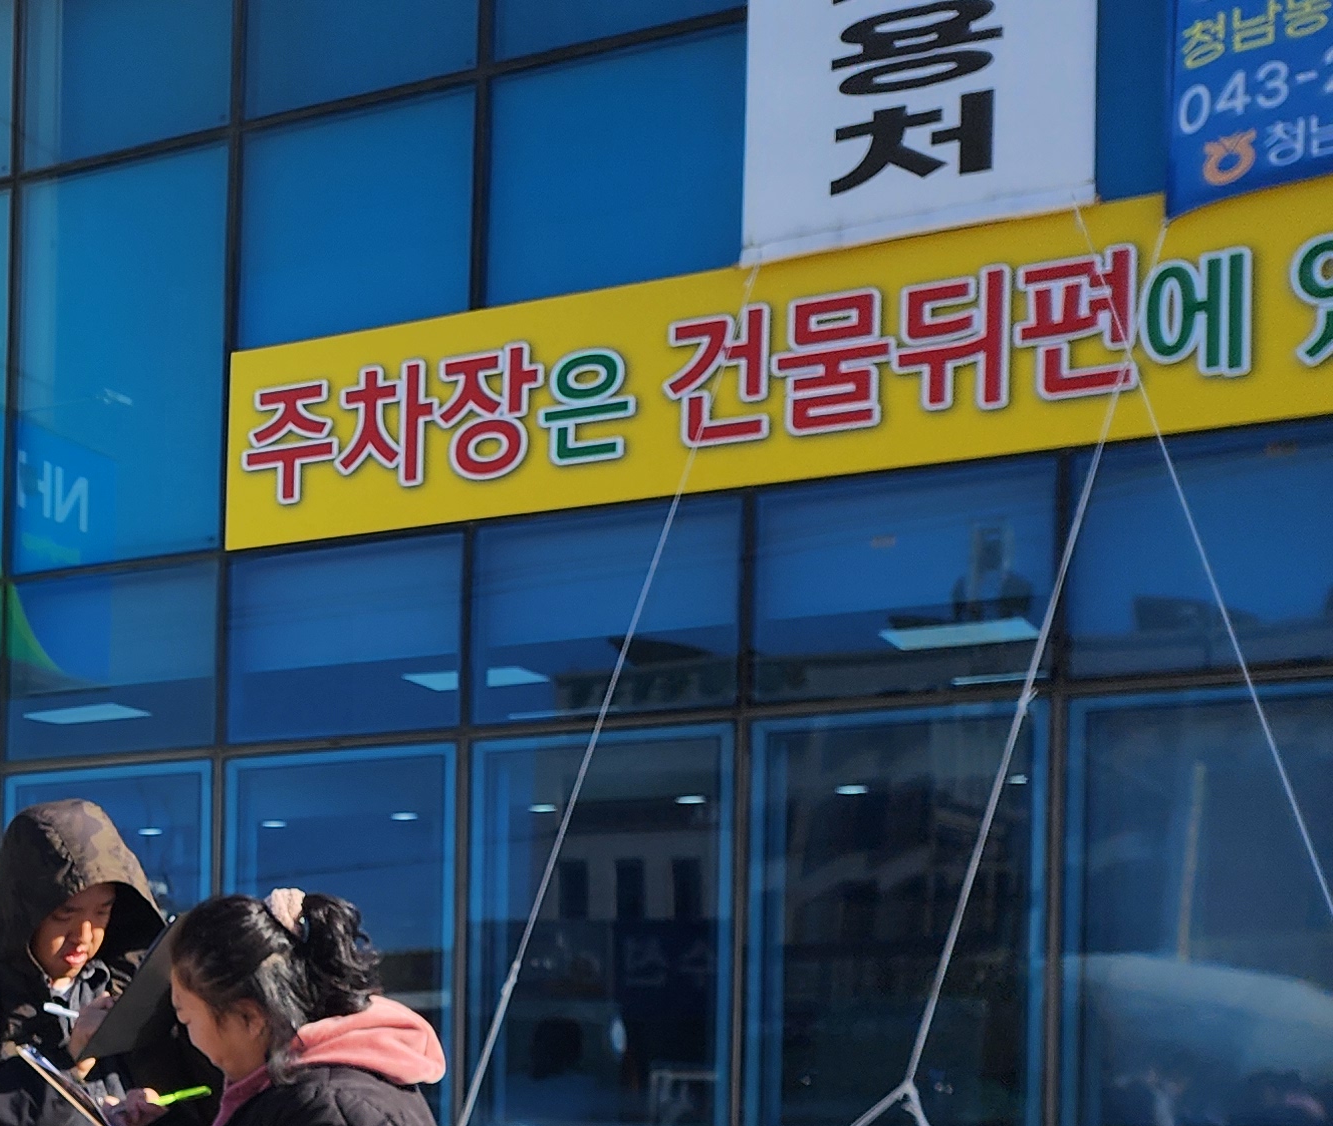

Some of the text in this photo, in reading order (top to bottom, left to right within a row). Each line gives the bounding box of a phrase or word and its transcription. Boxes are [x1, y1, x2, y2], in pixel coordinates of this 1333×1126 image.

[1179, 47, 1333, 135] 043-
[241, 340, 636, 505] 주차장은
[662, 243, 1253, 448] 건물뒤편에
